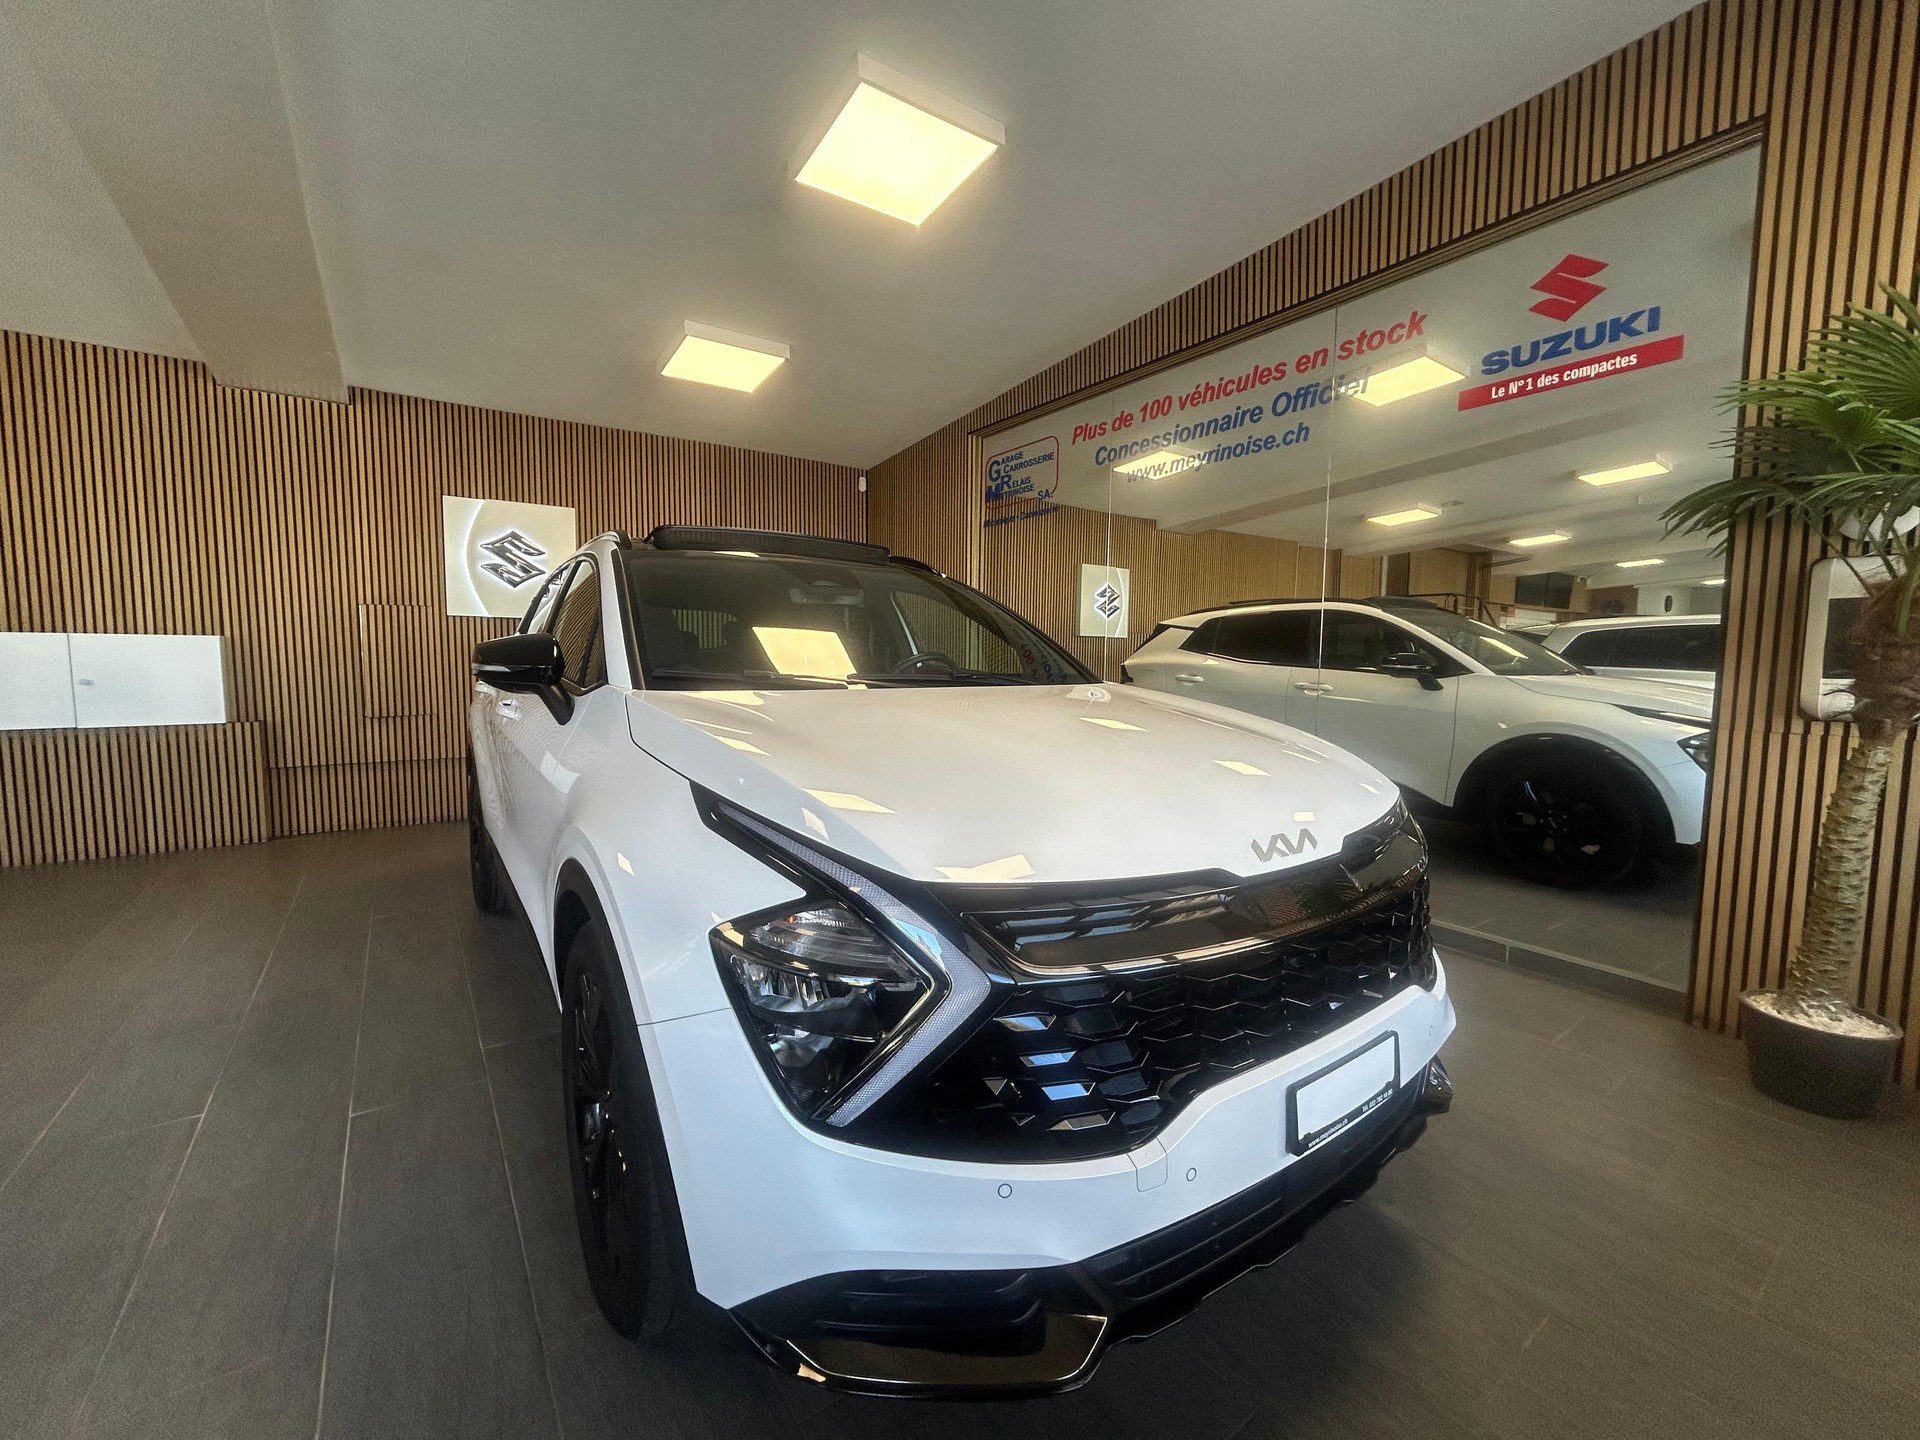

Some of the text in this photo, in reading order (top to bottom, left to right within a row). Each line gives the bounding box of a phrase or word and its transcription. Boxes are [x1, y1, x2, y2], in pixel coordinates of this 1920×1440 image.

[1481, 305, 1661, 376] SUZUKI
[1072, 310, 1428, 445] Plus de 100 véhicules en stock
[1491, 385, 1505, 399] Le
[1537, 372, 1559, 389] des
[1563, 352, 1638, 379] compactes
[1095, 367, 1372, 466] Concessionnaire Officiel
[988, 451, 1024, 482] GARAGE
[1003, 451, 1055, 475] CARROSSERIE
[1127, 422, 1310, 483] www.meyrinoise.ch
